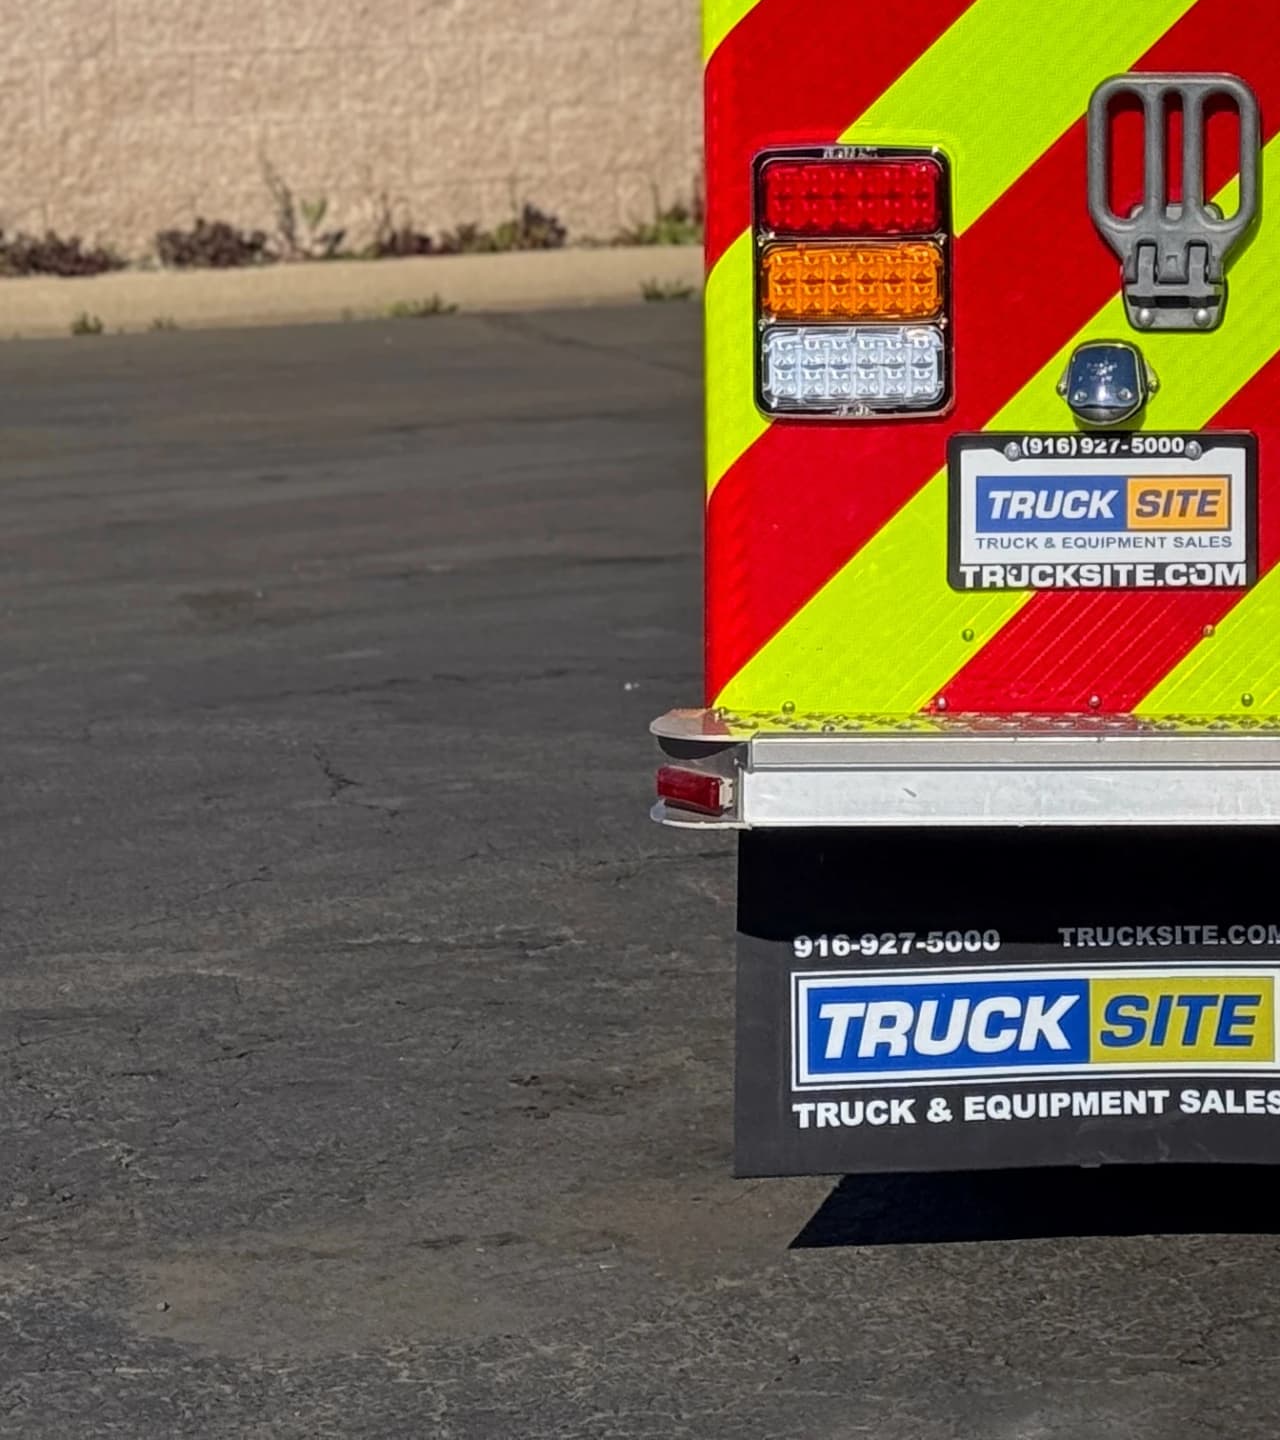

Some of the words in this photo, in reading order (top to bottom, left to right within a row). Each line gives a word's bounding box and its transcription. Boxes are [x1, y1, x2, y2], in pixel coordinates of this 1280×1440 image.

[988, 489, 1119, 520] TRUCK
[1135, 488, 1221, 518] SITE
[976, 537, 1039, 550] TRUCK
[1044, 536, 1056, 549] &
[1061, 536, 1167, 550] EQUIPMENT
[1173, 536, 1233, 549] SALES
[959, 563, 1248, 589] TRUCKSITE.COM
[793, 929, 1000, 959] 916-927-5000
[817, 993, 1081, 1061] TRUCK
[1099, 993, 1263, 1049] SITE
[792, 1099, 916, 1129] TRUCK
[926, 1097, 953, 1123] &
[963, 1089, 1170, 1122] EQUIPMENT
